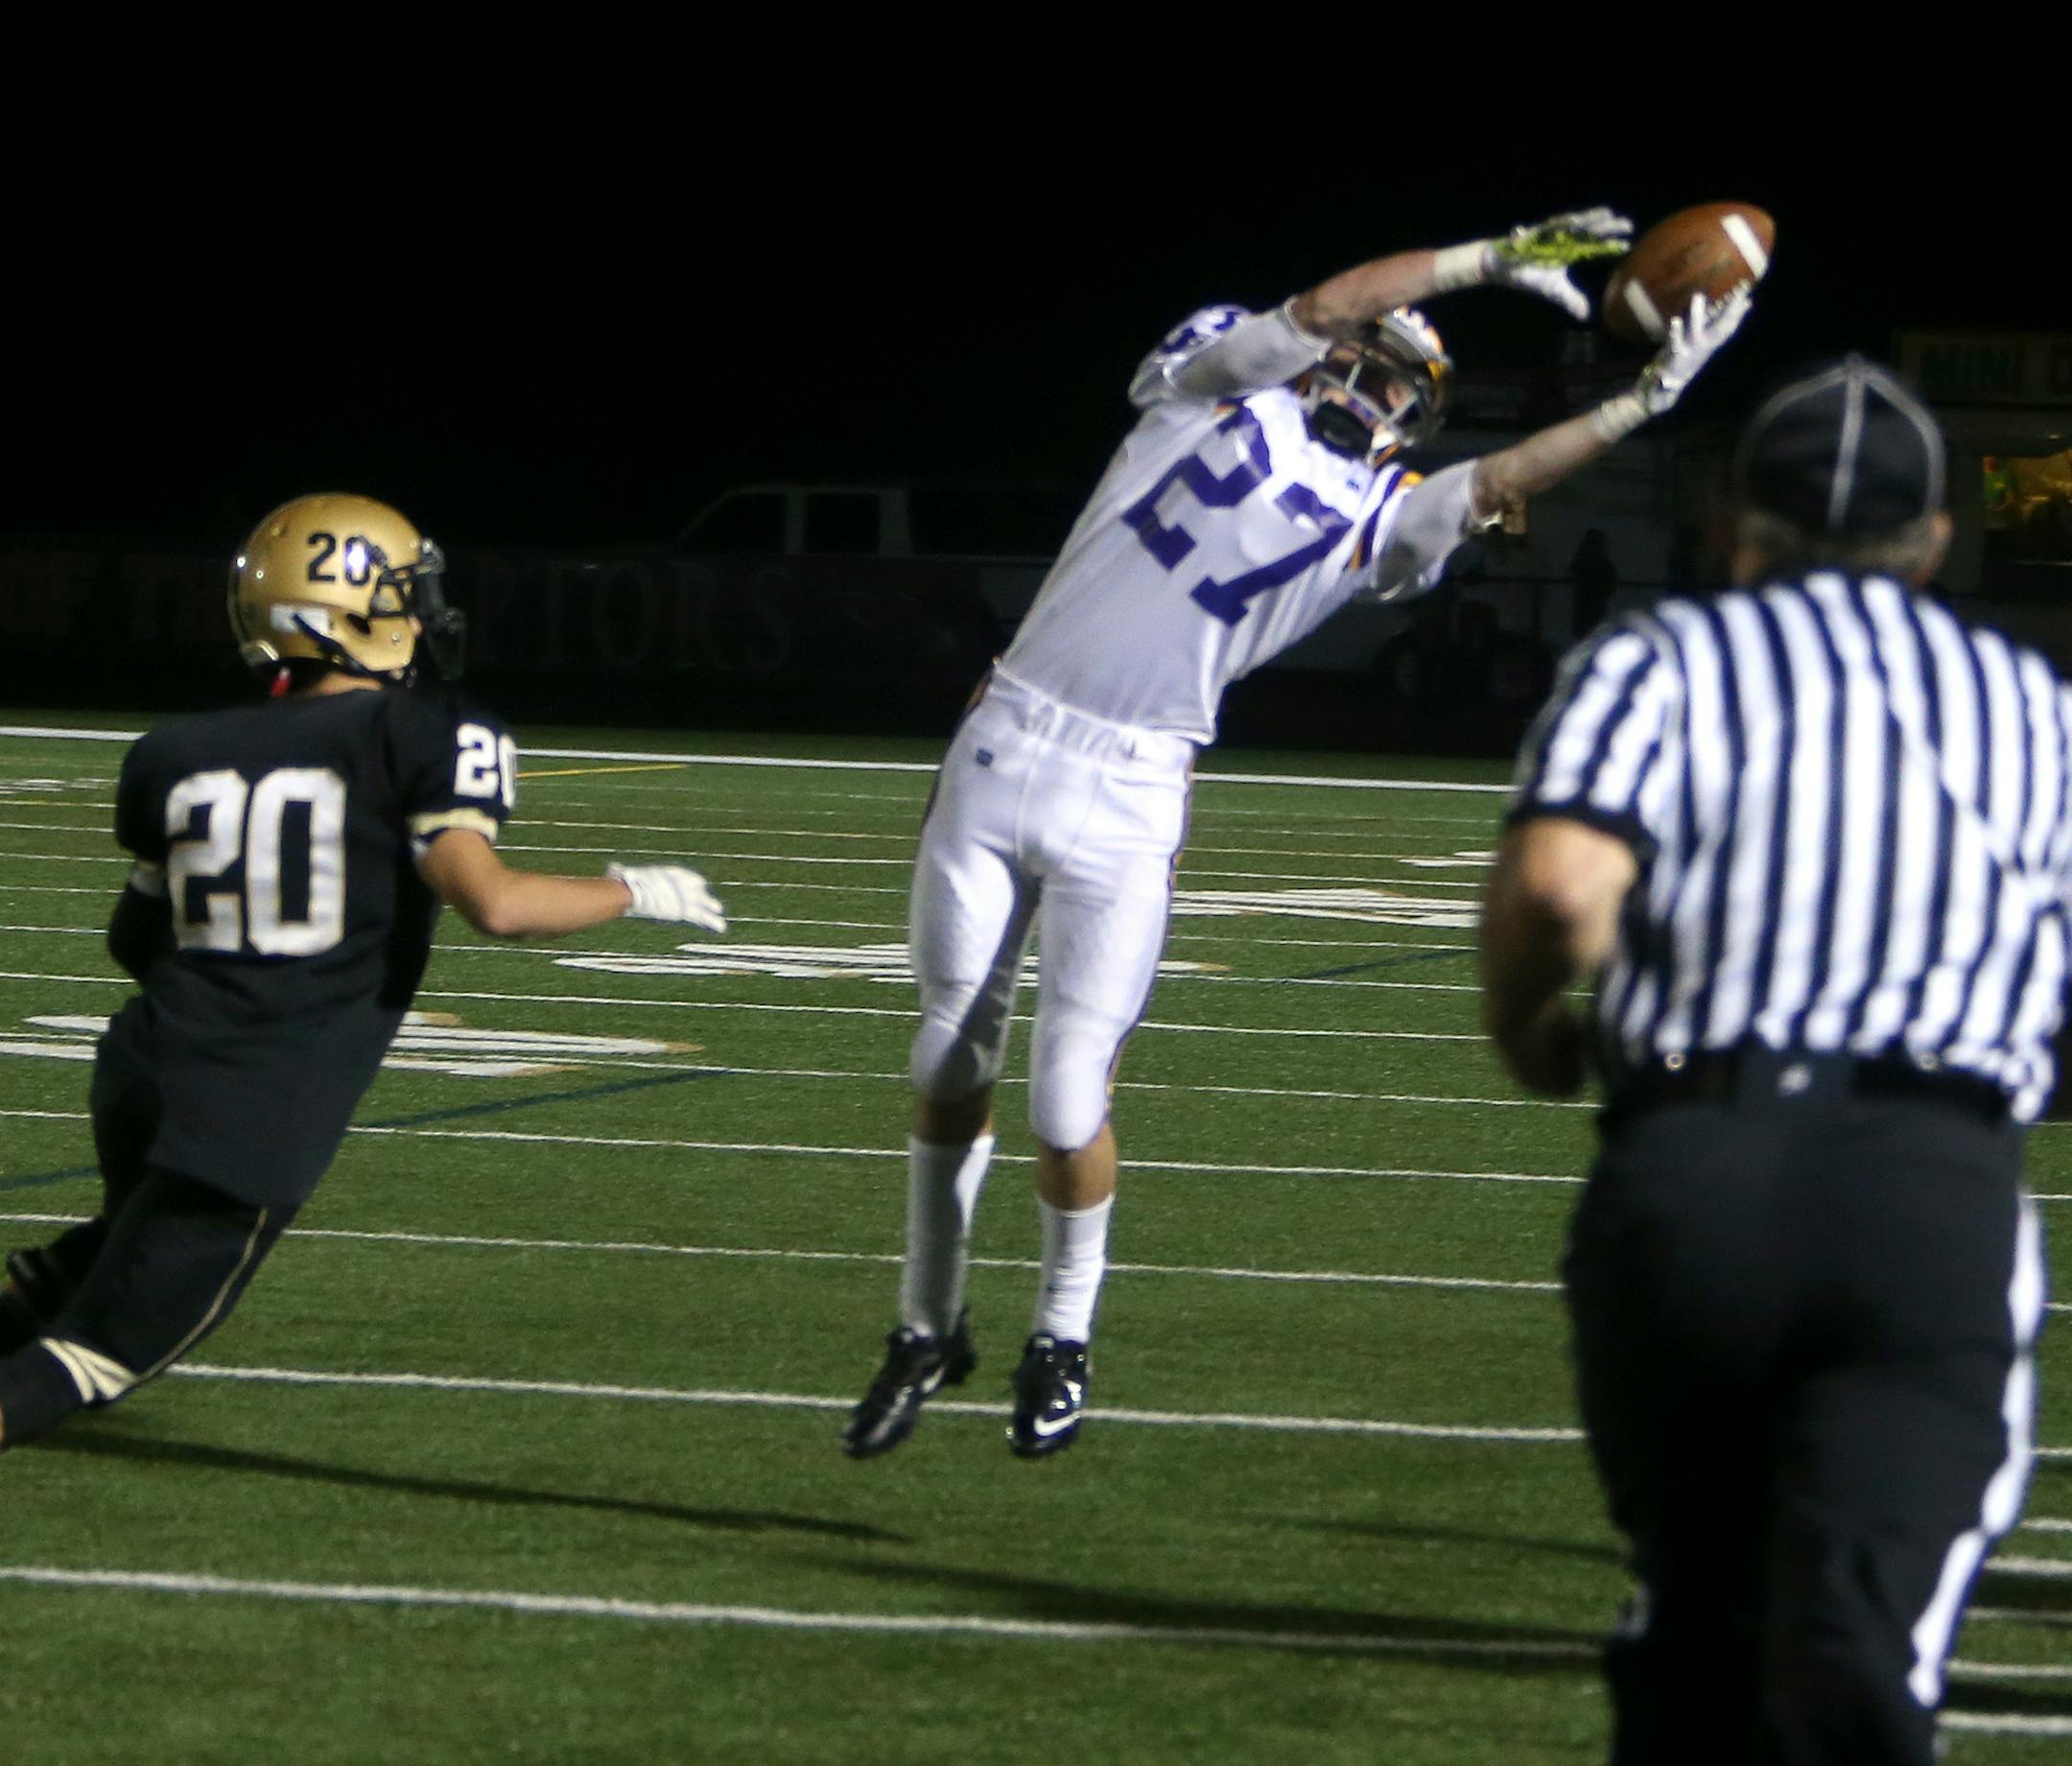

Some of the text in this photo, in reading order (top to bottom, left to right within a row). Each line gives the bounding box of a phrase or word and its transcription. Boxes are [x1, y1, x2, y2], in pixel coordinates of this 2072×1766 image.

[308, 533, 370, 586] 20
[1121, 396, 1354, 627] 27
[122, 554, 228, 642] TH
[468, 556, 790, 673] PTORS
[166, 767, 346, 956] 20
